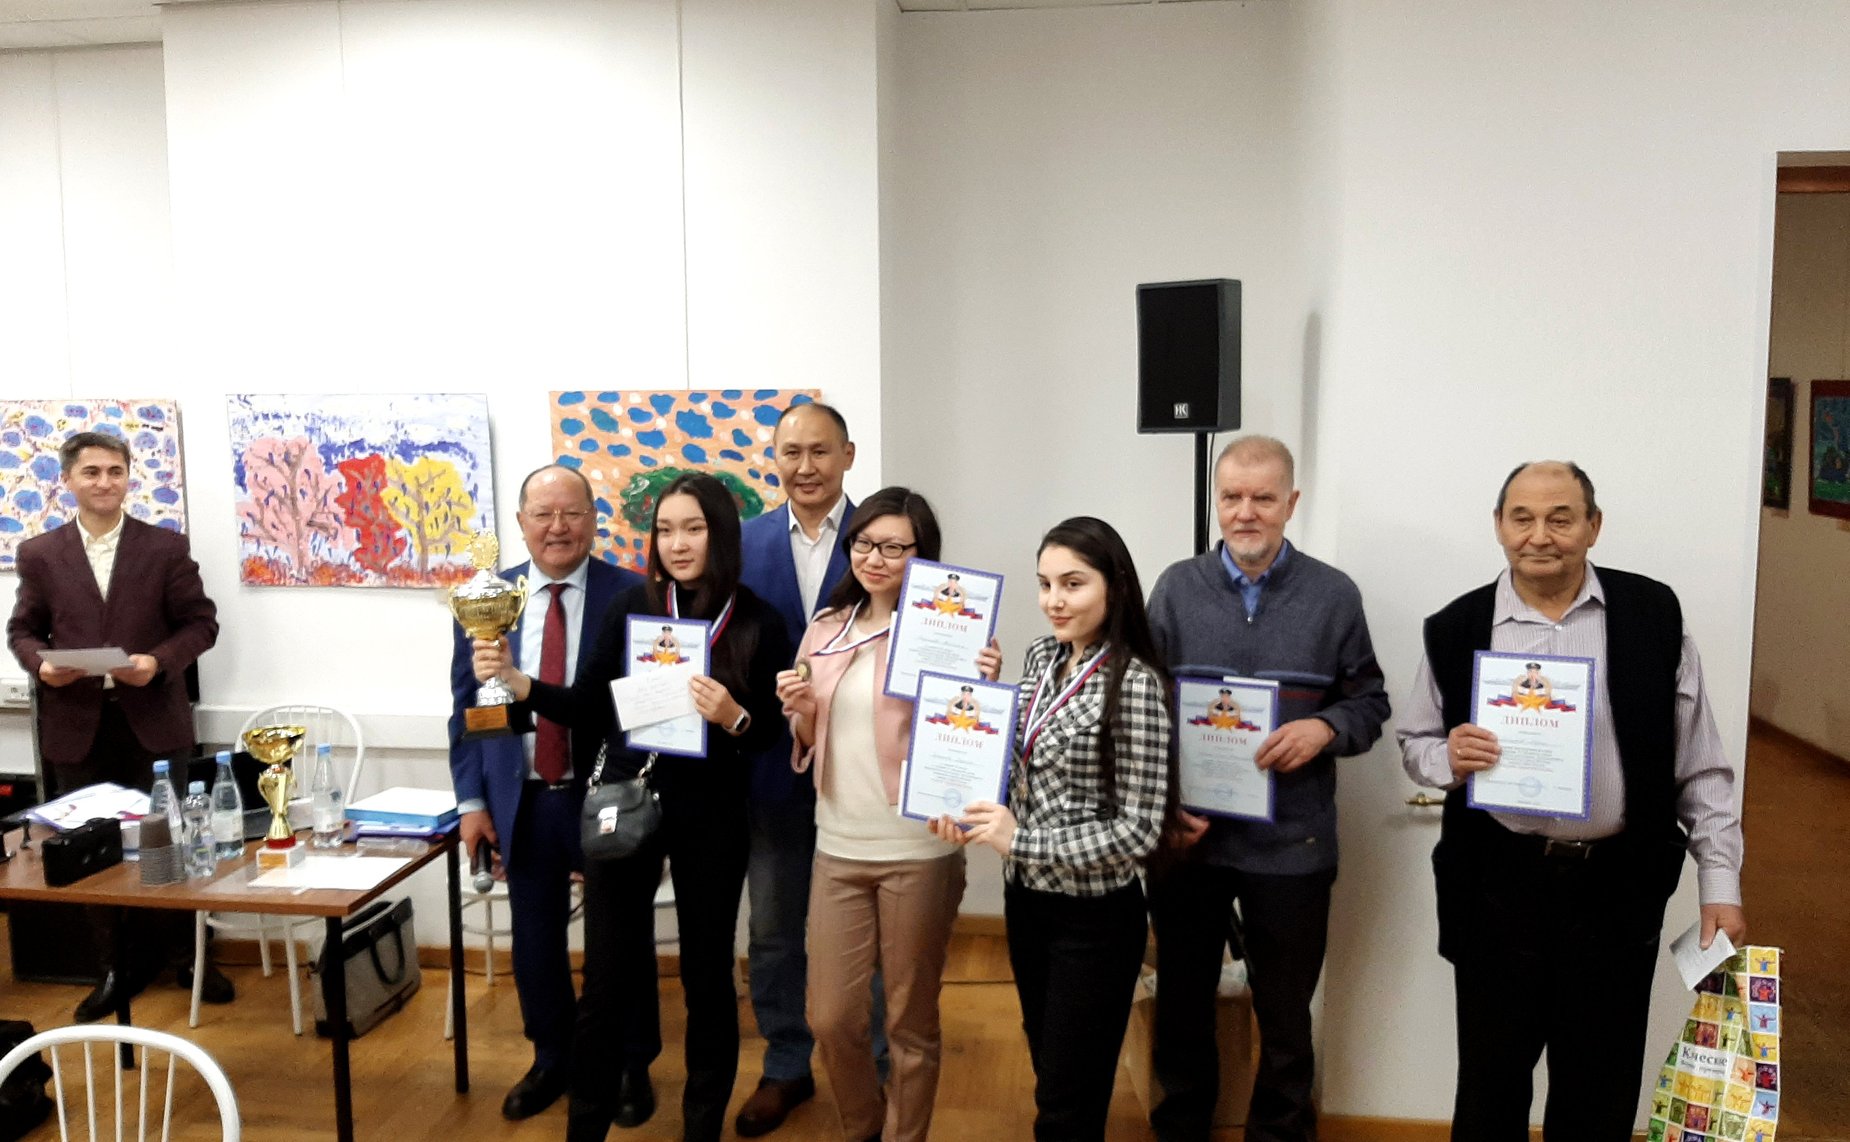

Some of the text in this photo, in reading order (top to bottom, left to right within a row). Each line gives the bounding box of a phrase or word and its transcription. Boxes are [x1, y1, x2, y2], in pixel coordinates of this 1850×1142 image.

[921, 617, 968, 633] ДИПЛОМ
[1501, 715, 1559, 728] ДИПЛОМ
[935, 732, 983, 749] ДИПЛОМ
[1200, 733, 1247, 745] ДИПЛОМ
